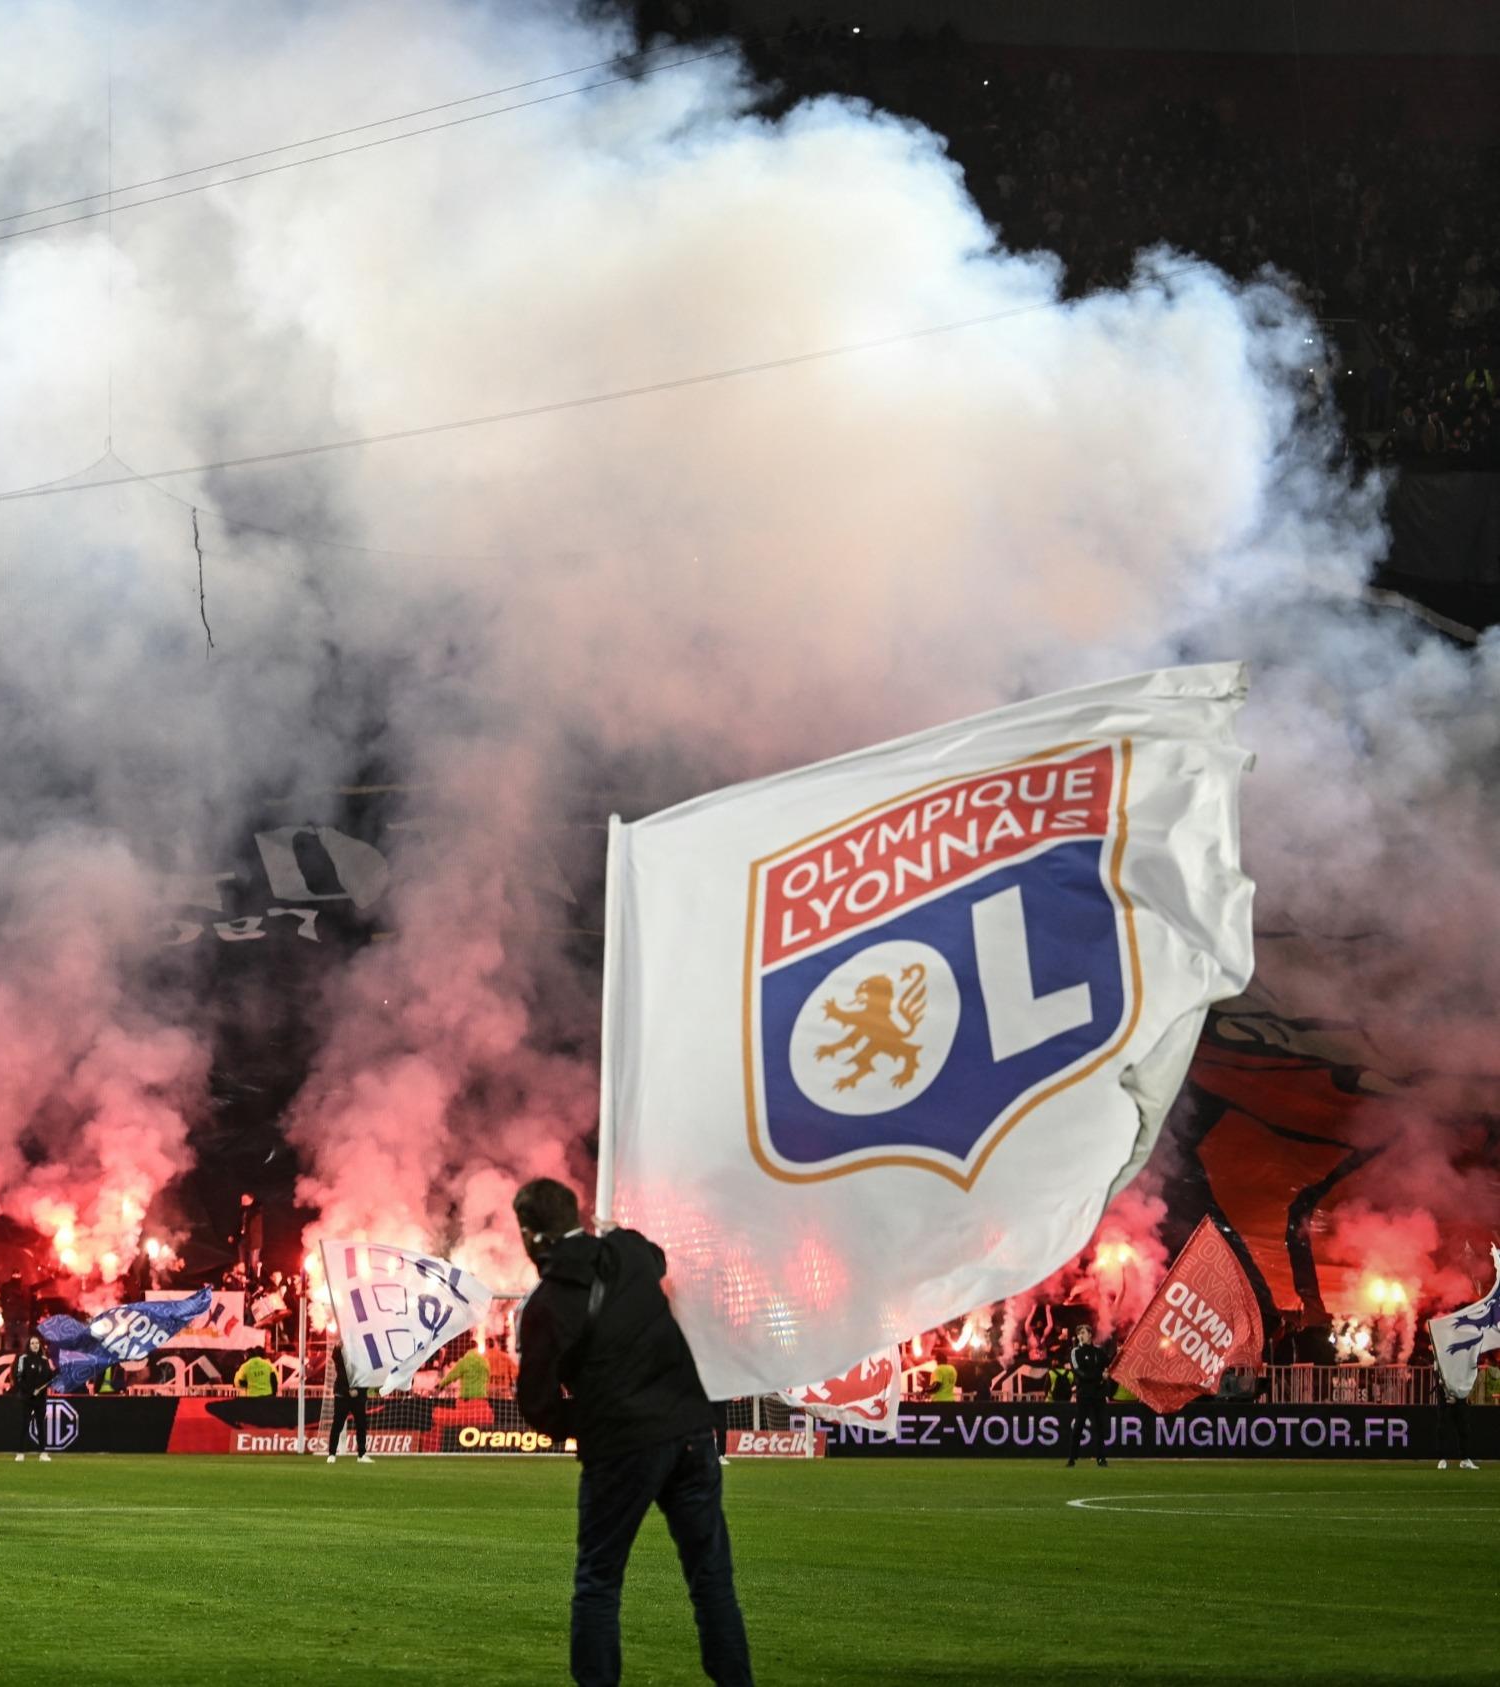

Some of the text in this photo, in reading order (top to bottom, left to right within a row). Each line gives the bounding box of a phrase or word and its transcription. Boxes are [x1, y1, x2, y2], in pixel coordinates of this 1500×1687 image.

[781, 765, 1096, 899] OLYMPIQUE
[781, 809, 1088, 947] LYONNAIS
[459, 1427, 552, 1451] Orange
[1156, 1416, 1409, 1447] MGMOTOR.FR
